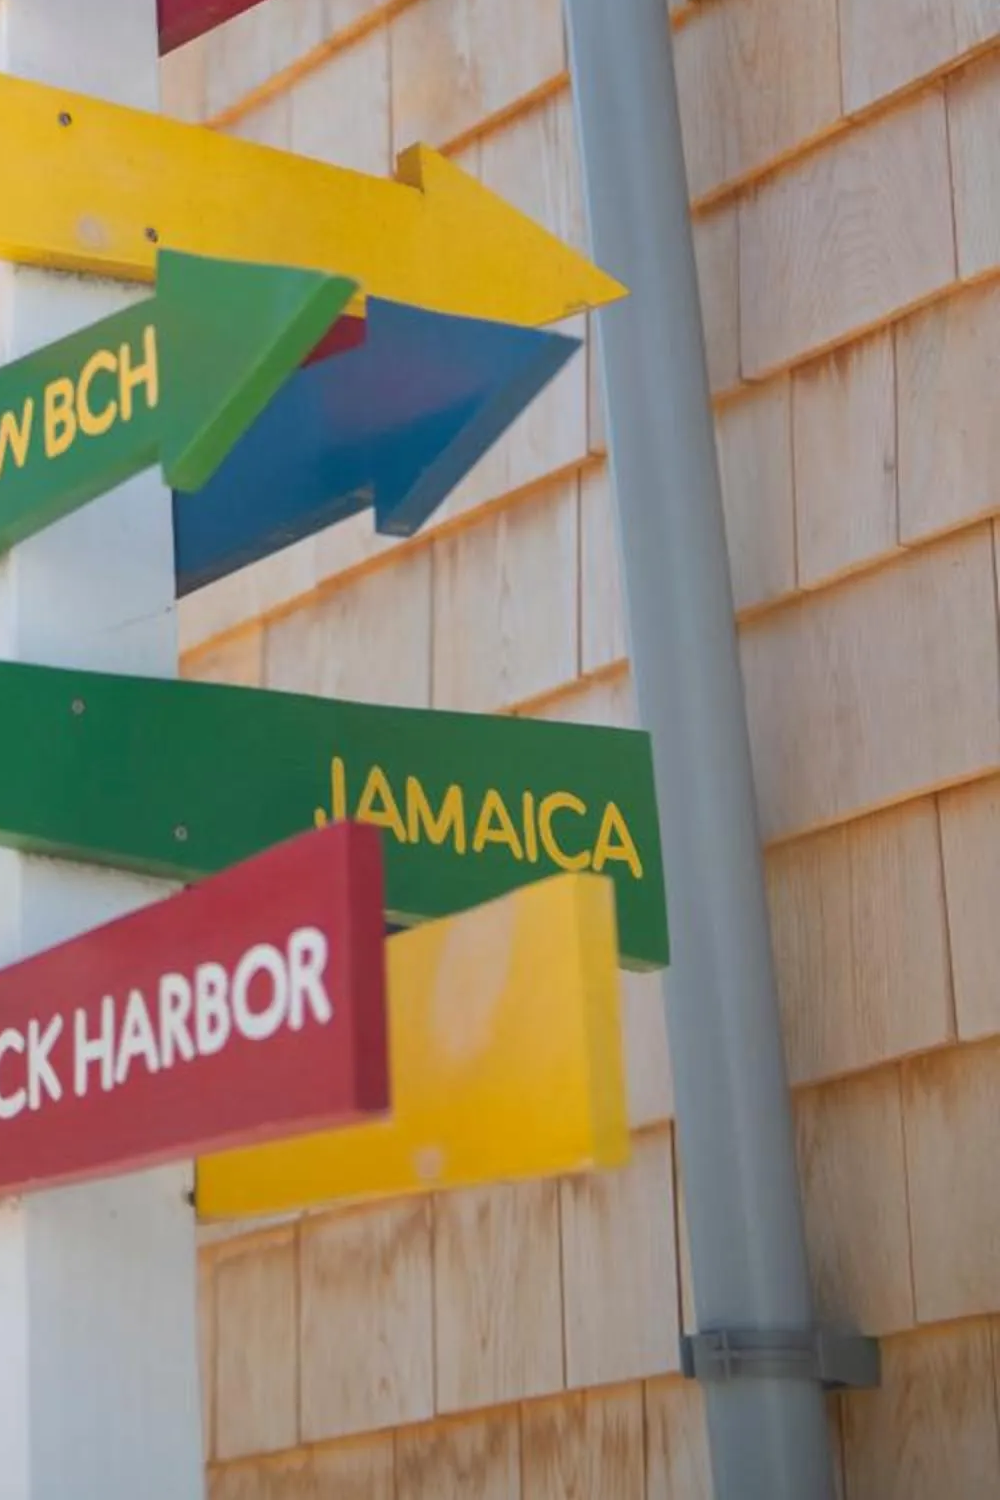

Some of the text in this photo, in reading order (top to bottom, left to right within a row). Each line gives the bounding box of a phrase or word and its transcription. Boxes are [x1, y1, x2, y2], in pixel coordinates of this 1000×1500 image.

[43, 324, 159, 458] BCH
[314, 755, 644, 880] JAMAICA
[74, 926, 333, 1098] HARBOR
